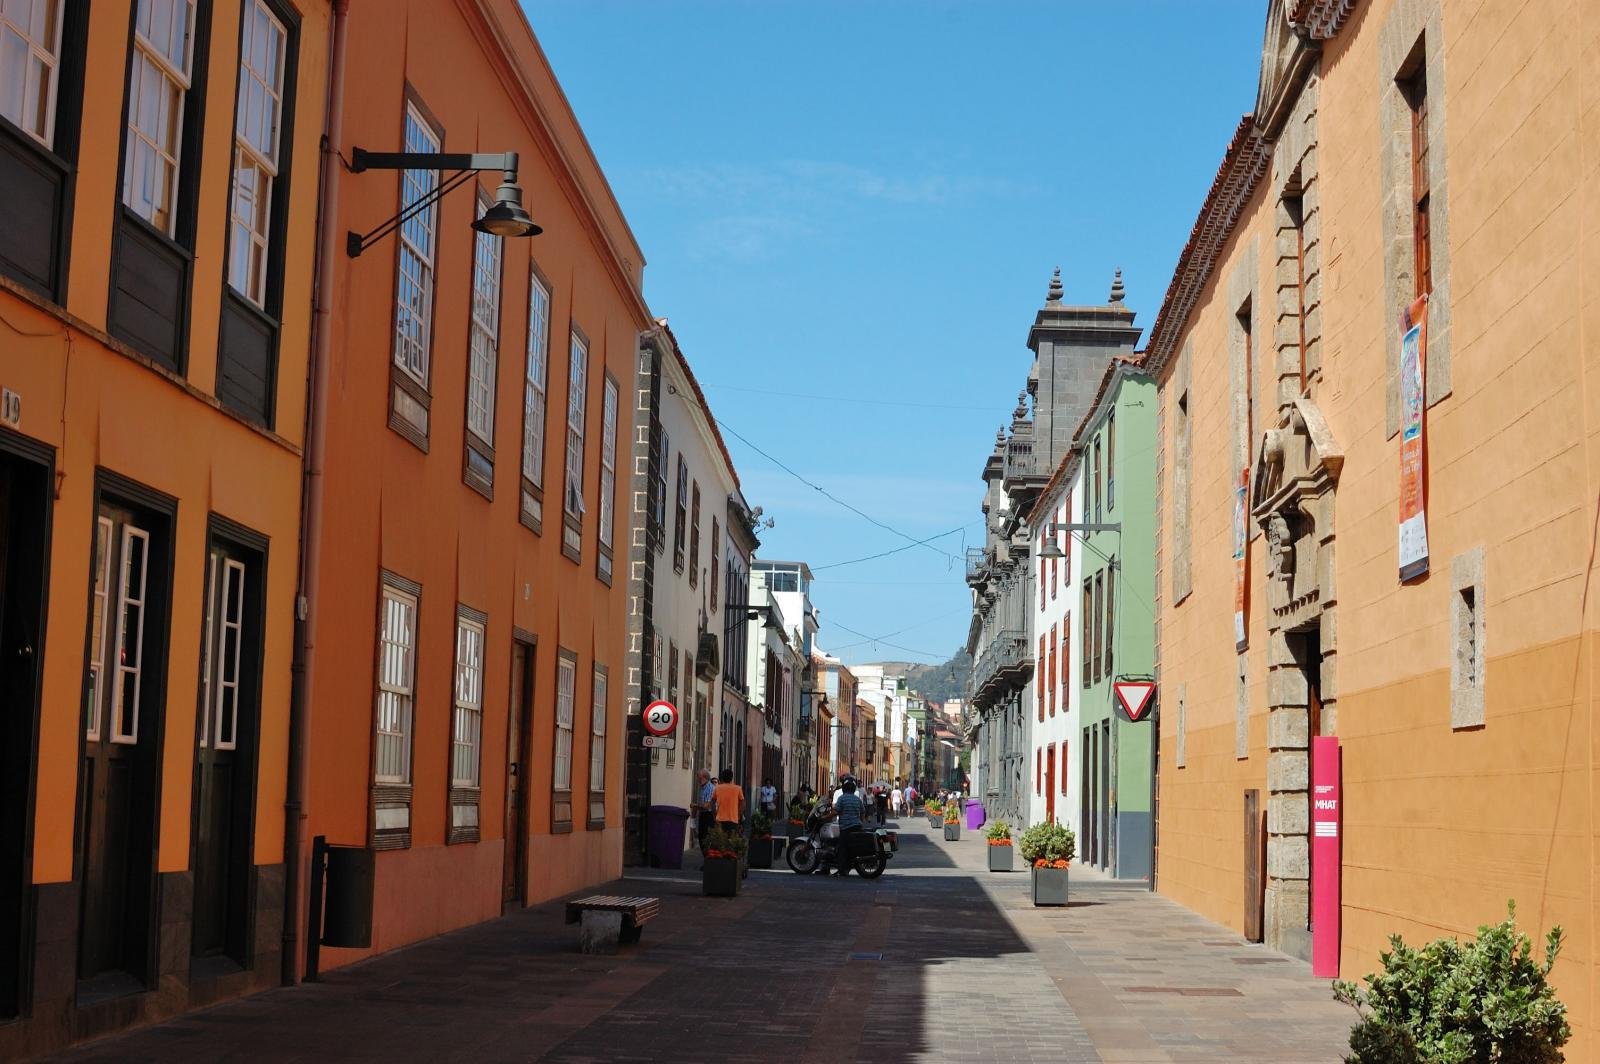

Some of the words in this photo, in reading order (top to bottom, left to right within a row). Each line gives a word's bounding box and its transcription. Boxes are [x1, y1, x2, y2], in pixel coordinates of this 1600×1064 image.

[6, 391, 20, 424] 19
[652, 712, 671, 724] 20
[1315, 799, 1336, 810] MHAT
